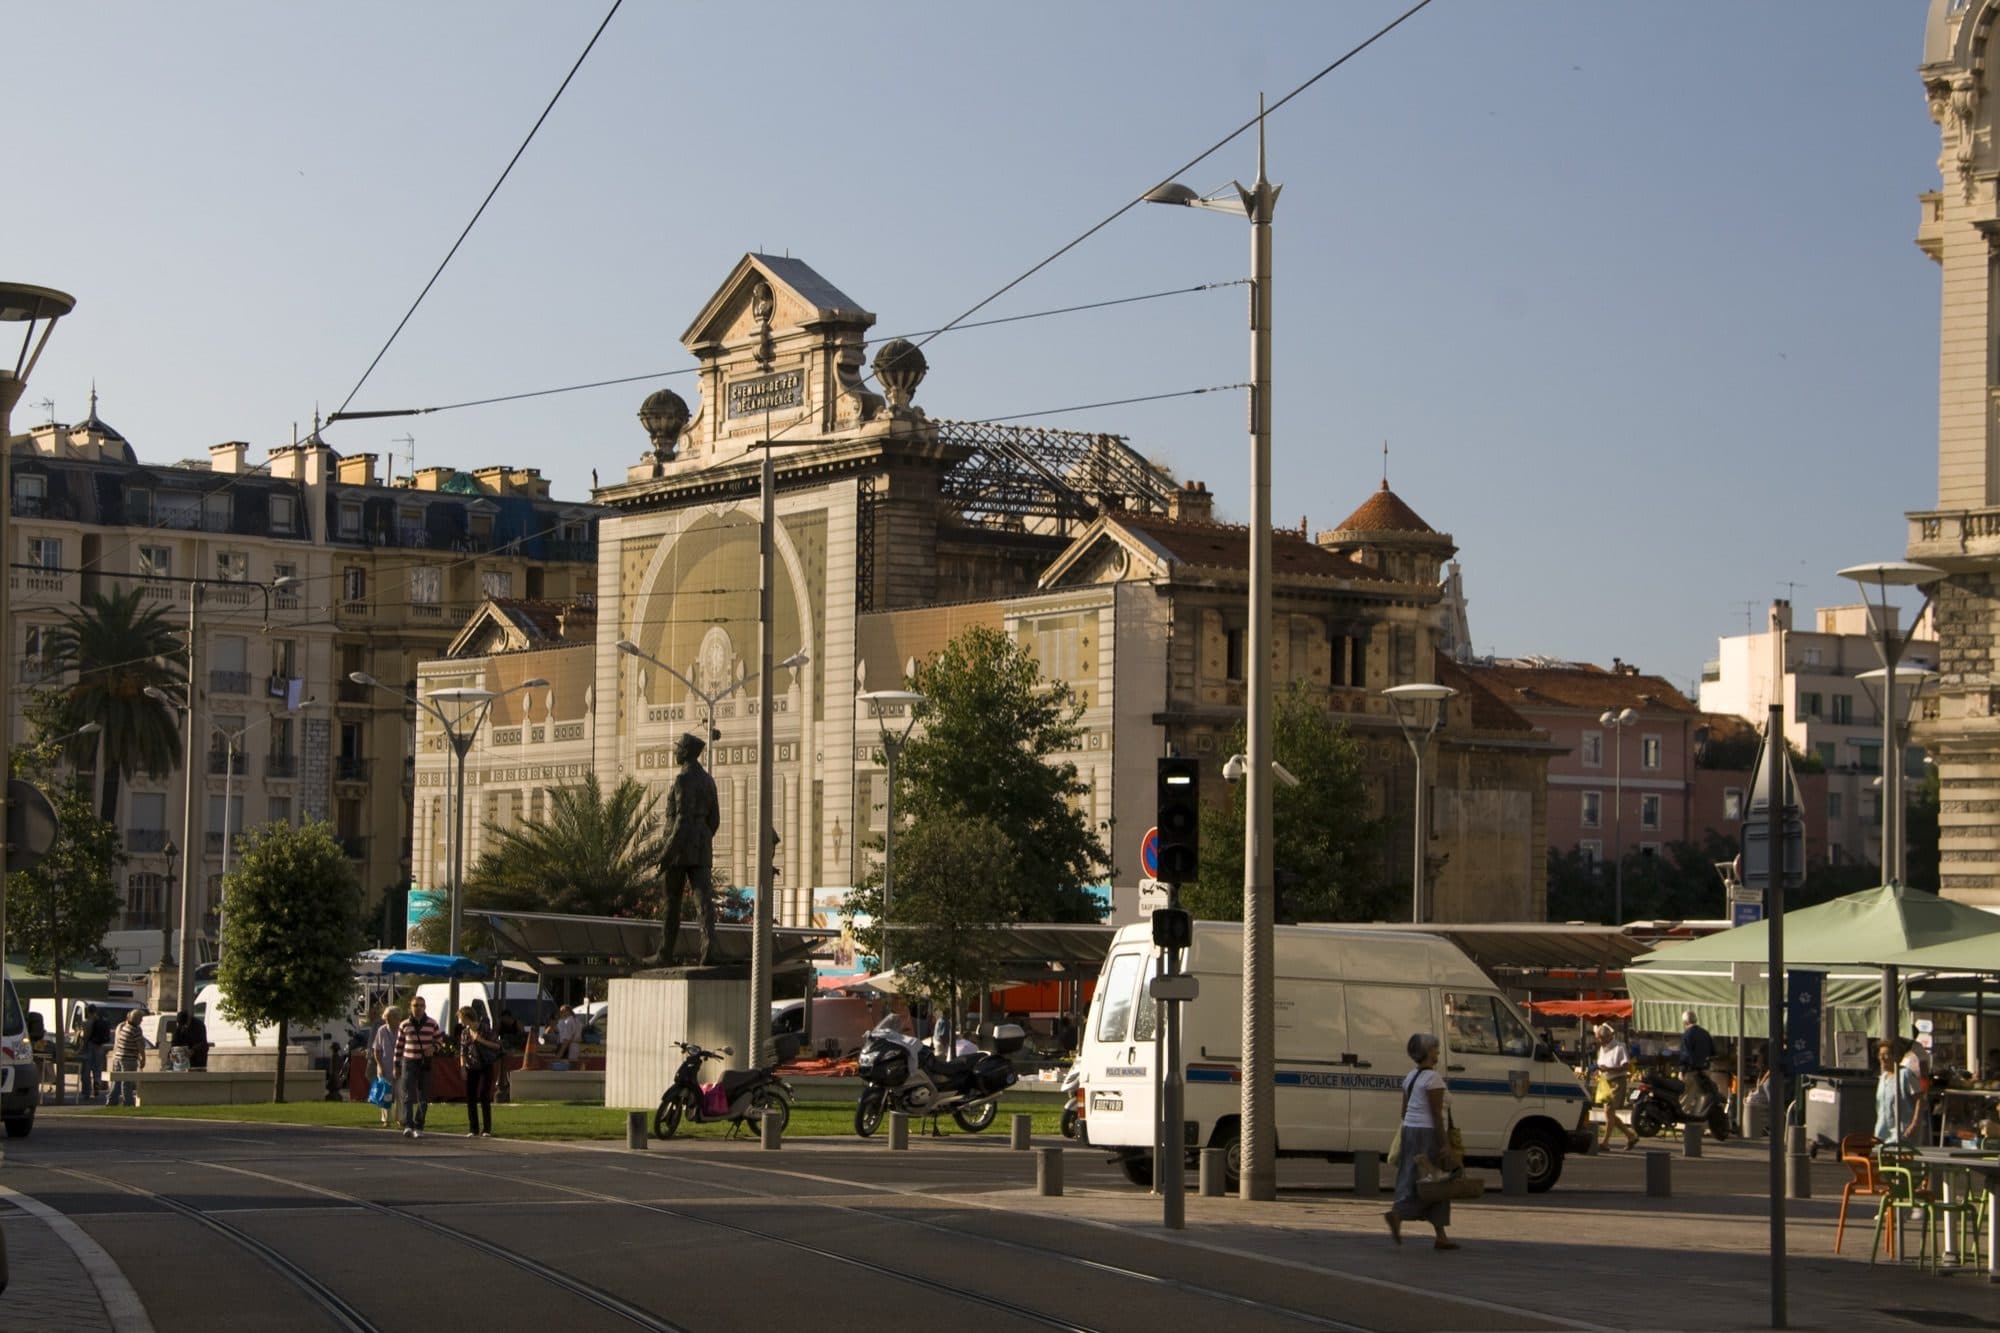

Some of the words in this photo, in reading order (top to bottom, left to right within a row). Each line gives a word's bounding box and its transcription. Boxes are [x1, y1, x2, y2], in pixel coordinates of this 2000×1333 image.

[732, 383, 766, 399] CHEMINS
[769, 380, 779, 392] DE
[782, 376, 798, 389] FER
[737, 400, 746, 413] DE
[747, 399, 756, 410] LA
[757, 393, 793, 408] PROVENCE
[1302, 1072, 1337, 1086] POLICE
[1341, 1074, 1403, 1088] MUNICIPALE
